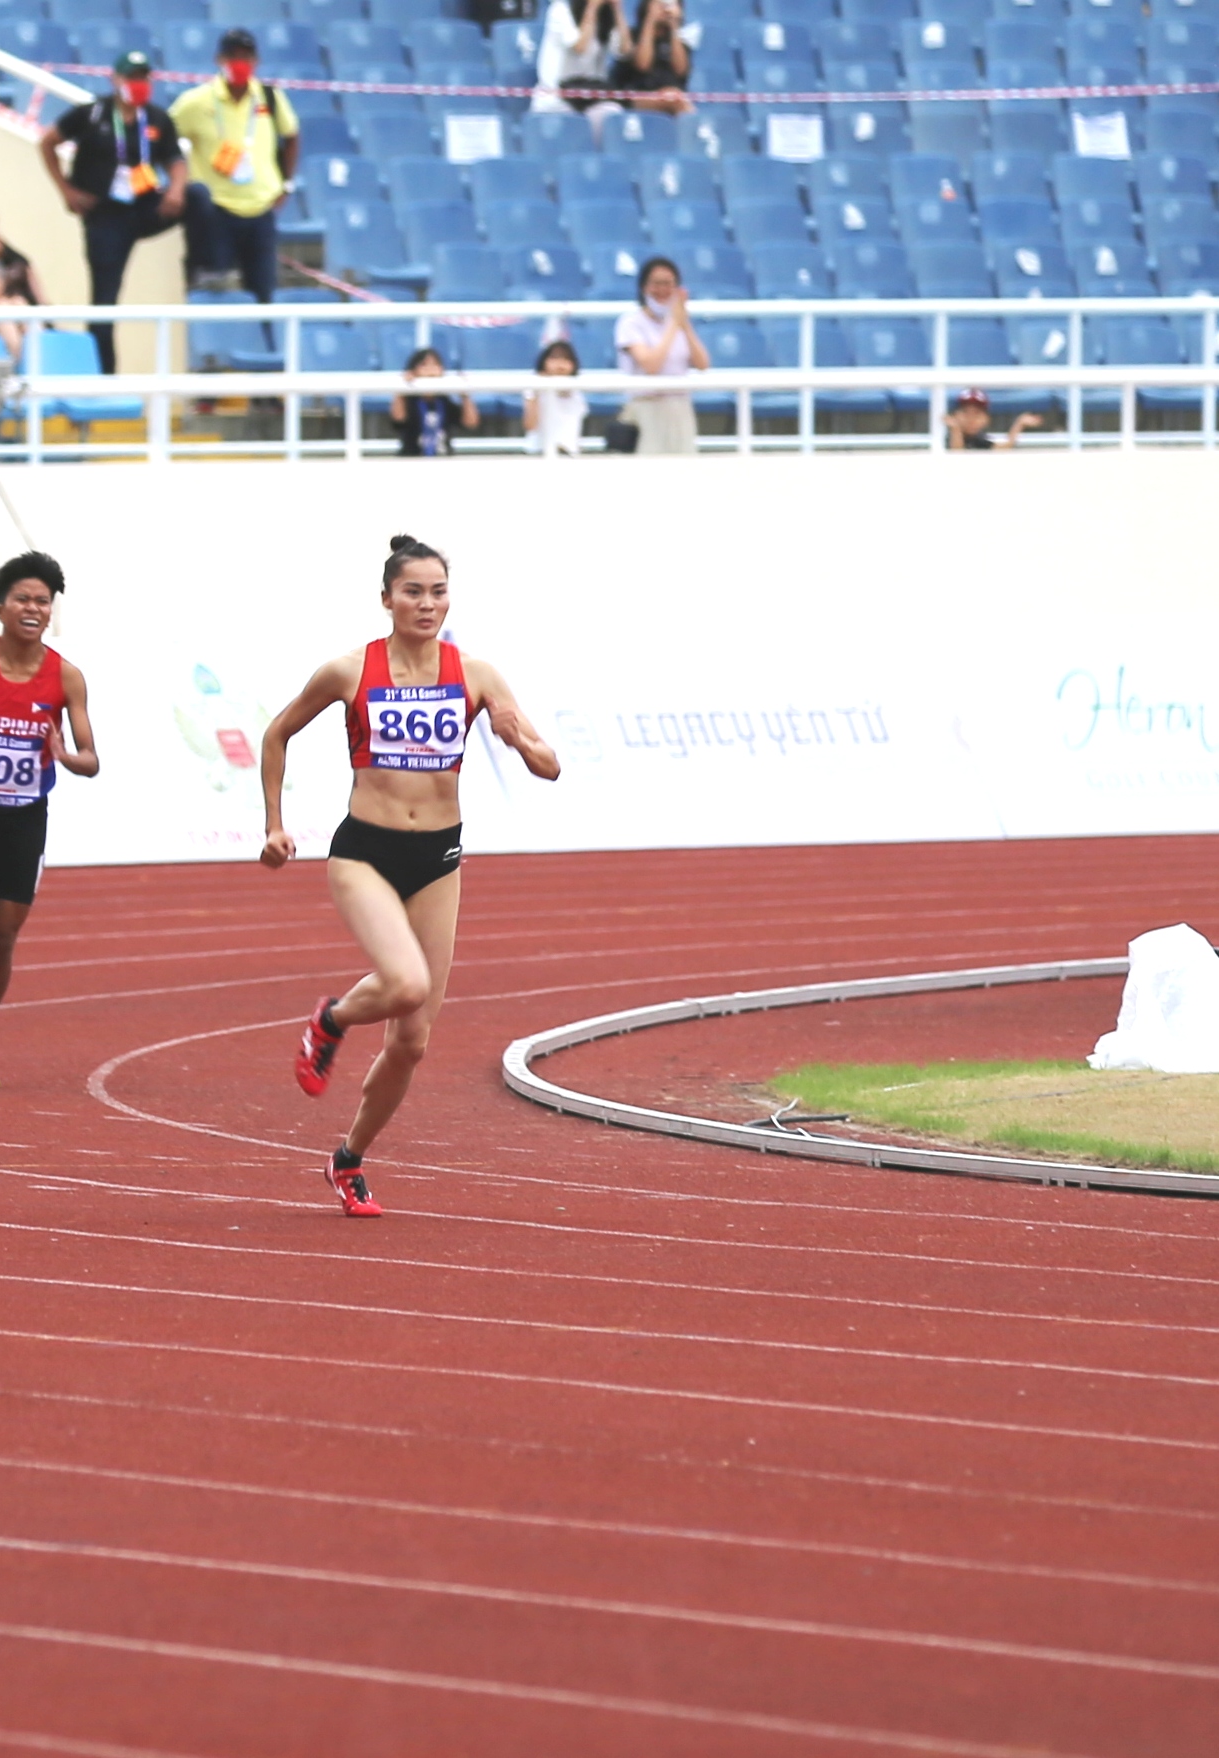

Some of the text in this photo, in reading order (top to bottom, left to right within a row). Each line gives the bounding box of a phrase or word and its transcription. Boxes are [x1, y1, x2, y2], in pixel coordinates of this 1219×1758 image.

[400, 688, 418, 701] SEA
[379, 707, 459, 745] 866
[615, 710, 757, 758] LEGACY
